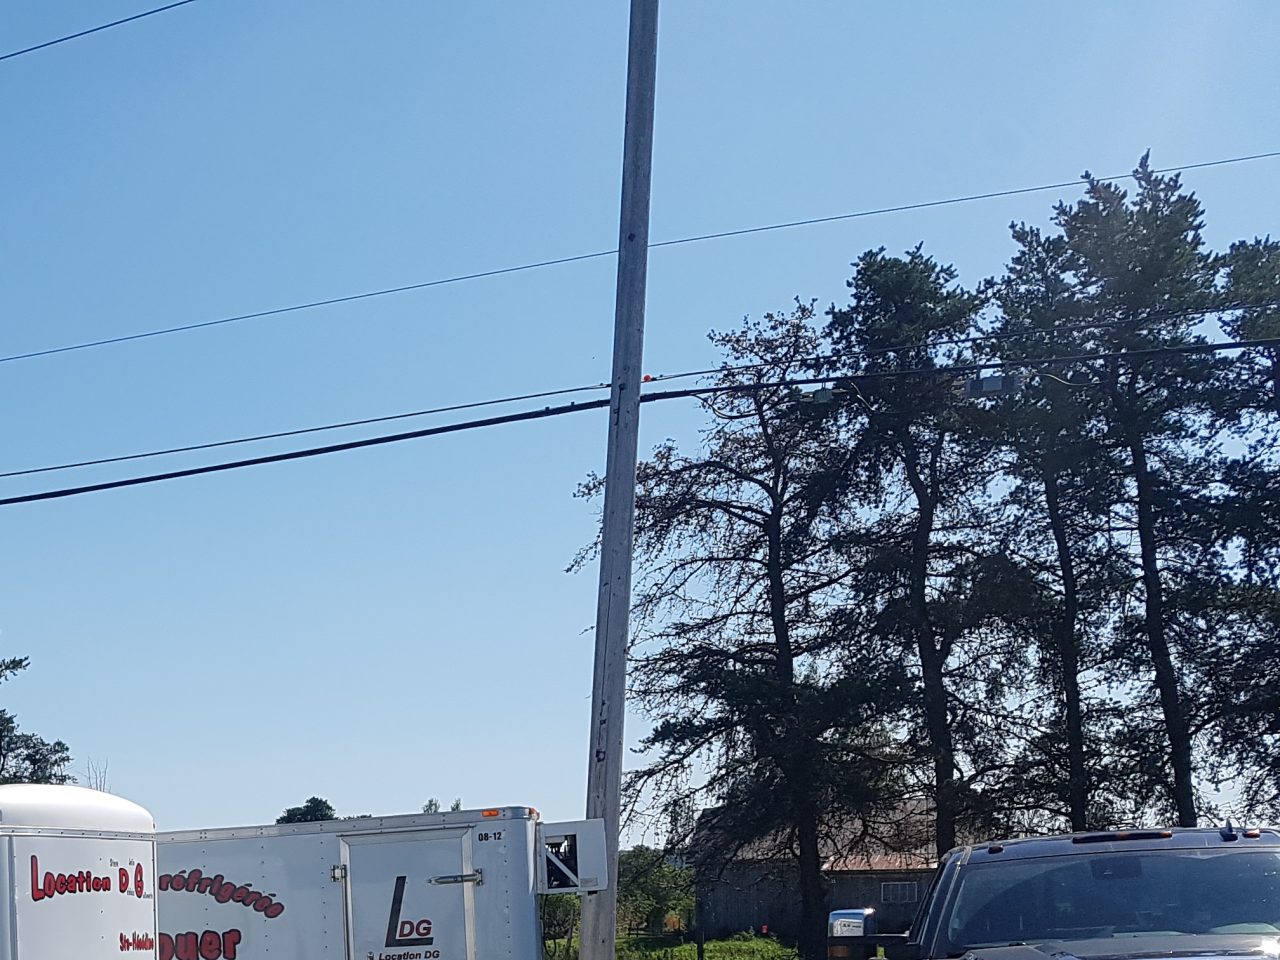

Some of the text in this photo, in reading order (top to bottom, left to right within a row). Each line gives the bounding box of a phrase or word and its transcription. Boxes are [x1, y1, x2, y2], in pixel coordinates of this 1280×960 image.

[478, 831, 502, 842] 08-12
[31, 855, 111, 901] Location
[159, 869, 284, 918] réfrigérée
[398, 919, 432, 938] DG
[379, 950, 440, 960] Location DG
